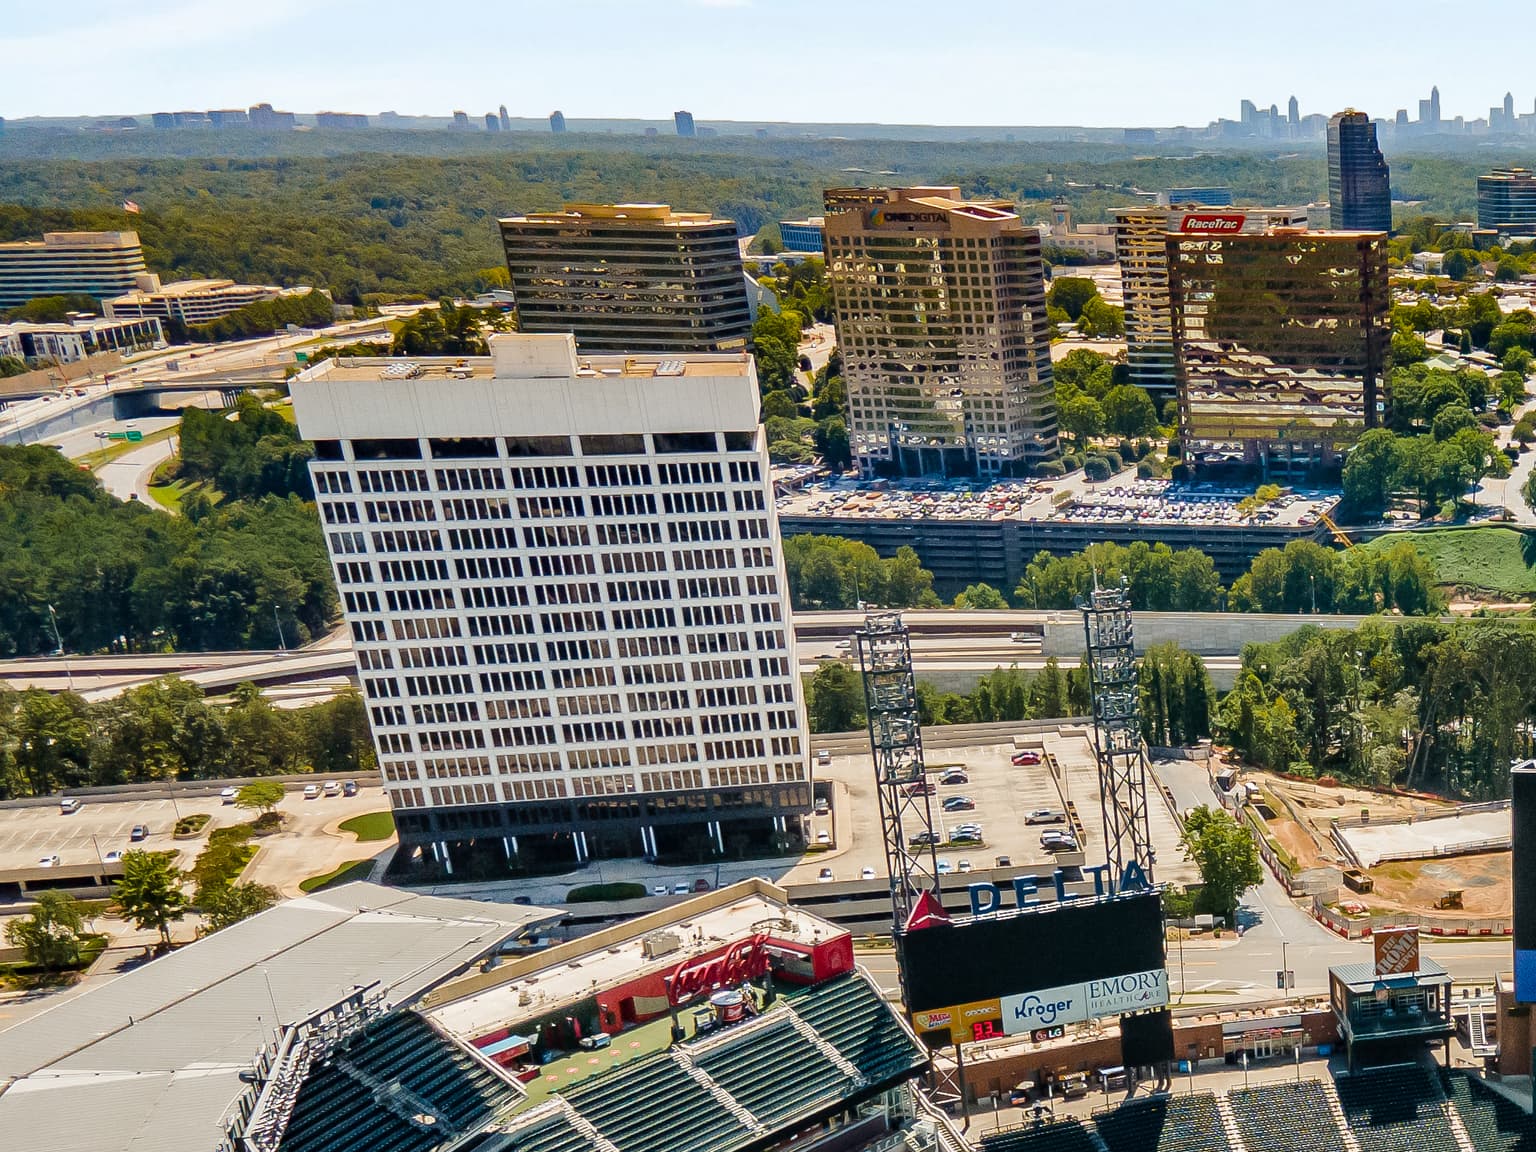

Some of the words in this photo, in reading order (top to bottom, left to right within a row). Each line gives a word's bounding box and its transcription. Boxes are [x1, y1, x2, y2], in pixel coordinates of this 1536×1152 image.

[884, 211, 950, 224] ONEDIGITAL
[1186, 217, 1238, 231] RaceTrac
[968, 860, 1151, 915] DELTA
[1376, 932, 1417, 973] HOME
[1089, 971, 1162, 998] EMORY
[1015, 995, 1073, 1024] Kroger
[1049, 1028, 1063, 1038] LG
